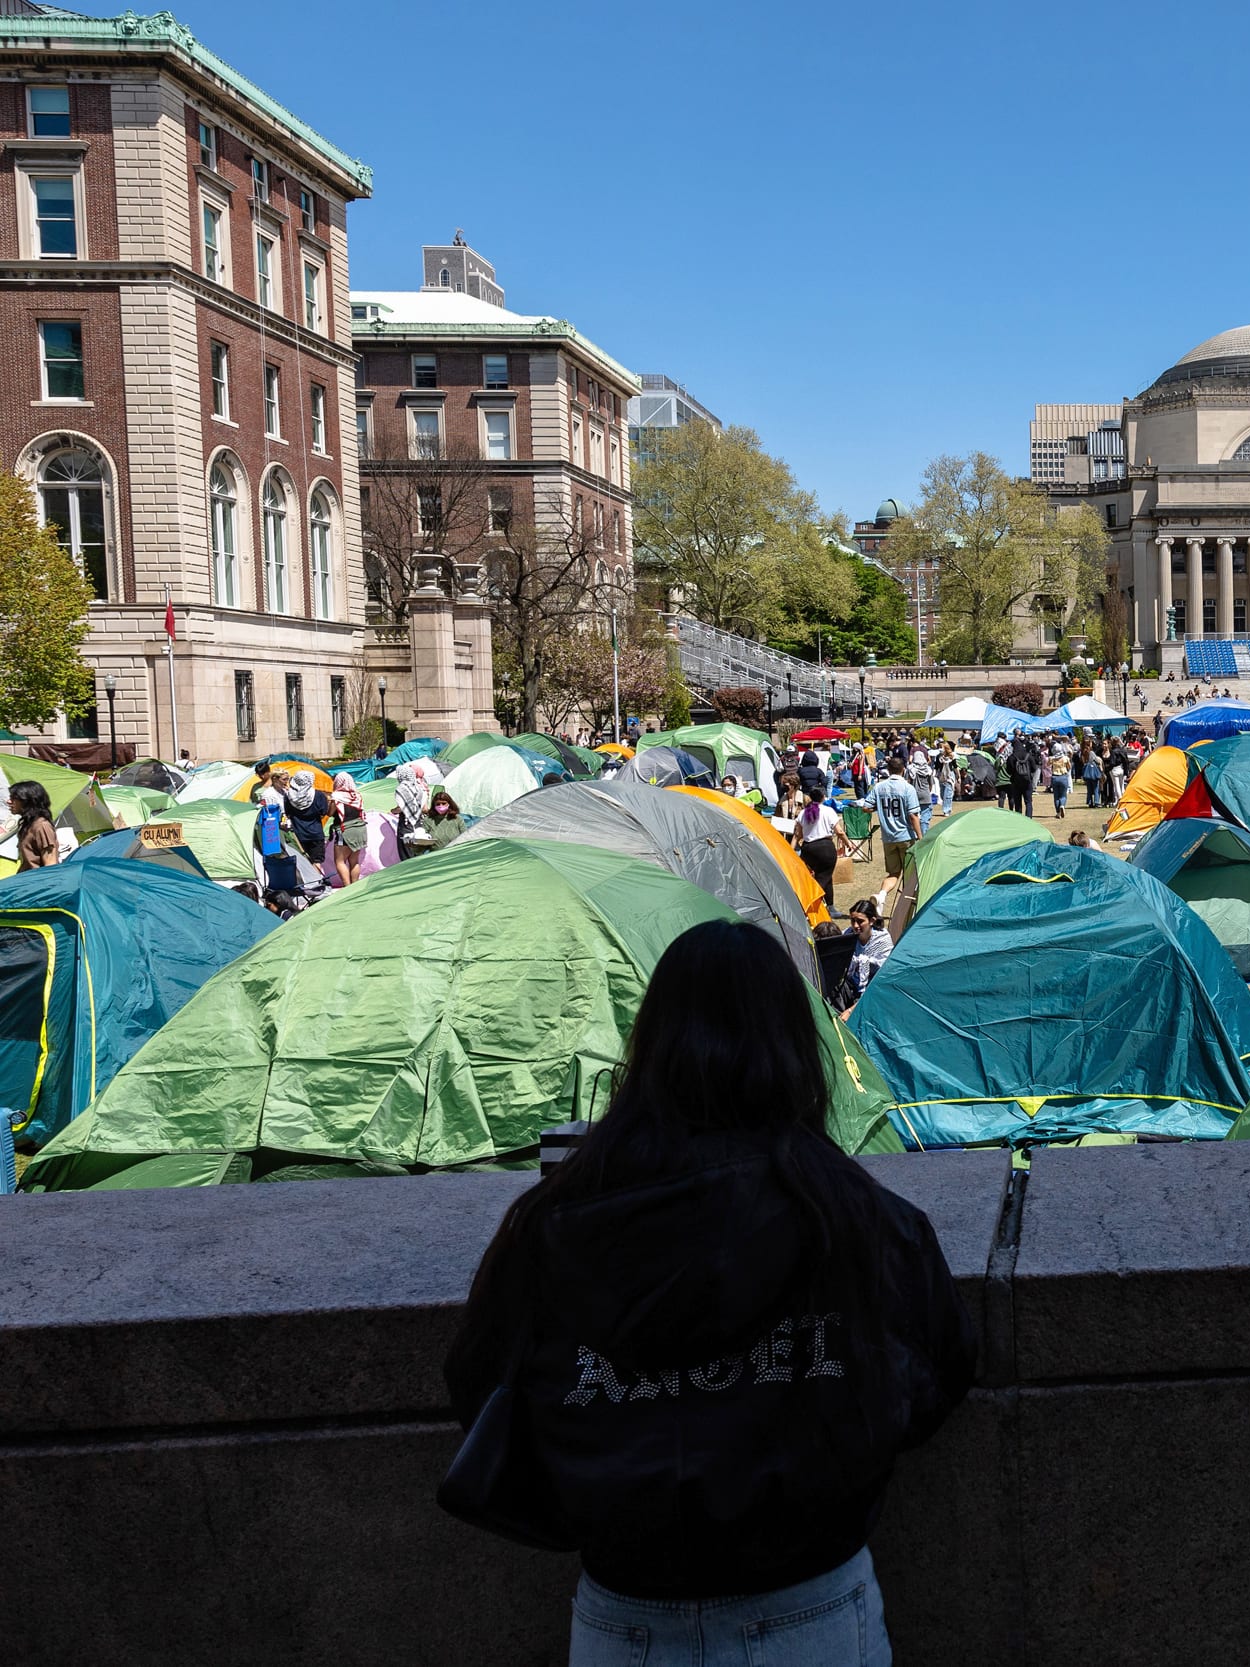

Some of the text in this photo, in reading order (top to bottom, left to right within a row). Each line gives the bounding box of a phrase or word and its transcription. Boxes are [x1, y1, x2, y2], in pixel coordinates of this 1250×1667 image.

[881, 797, 901, 817] 48
[143, 828, 181, 840] CU ALUMNI
